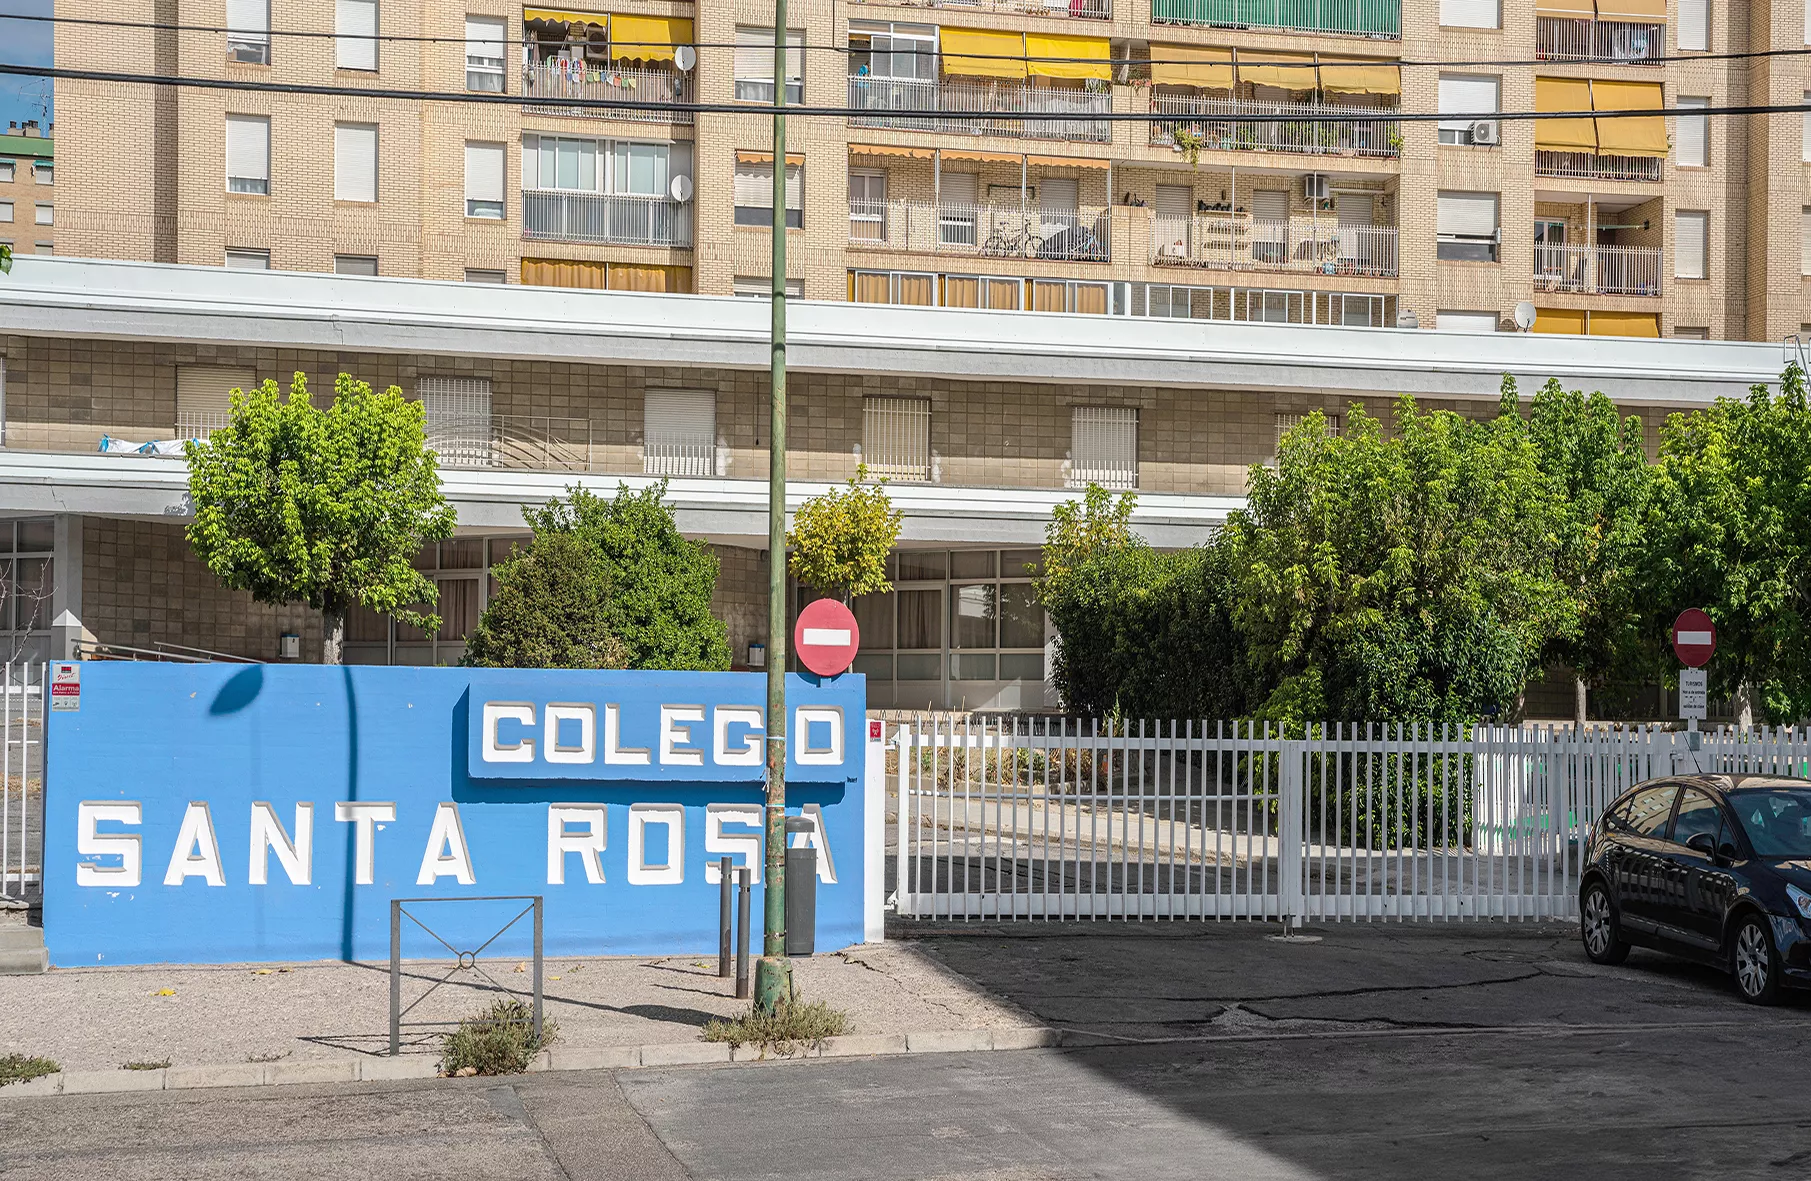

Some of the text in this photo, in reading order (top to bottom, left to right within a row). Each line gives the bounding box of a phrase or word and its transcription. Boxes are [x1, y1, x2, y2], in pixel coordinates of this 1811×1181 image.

[482, 701, 845, 767] COLEGO
[76, 800, 838, 888] SANTA ROSA
